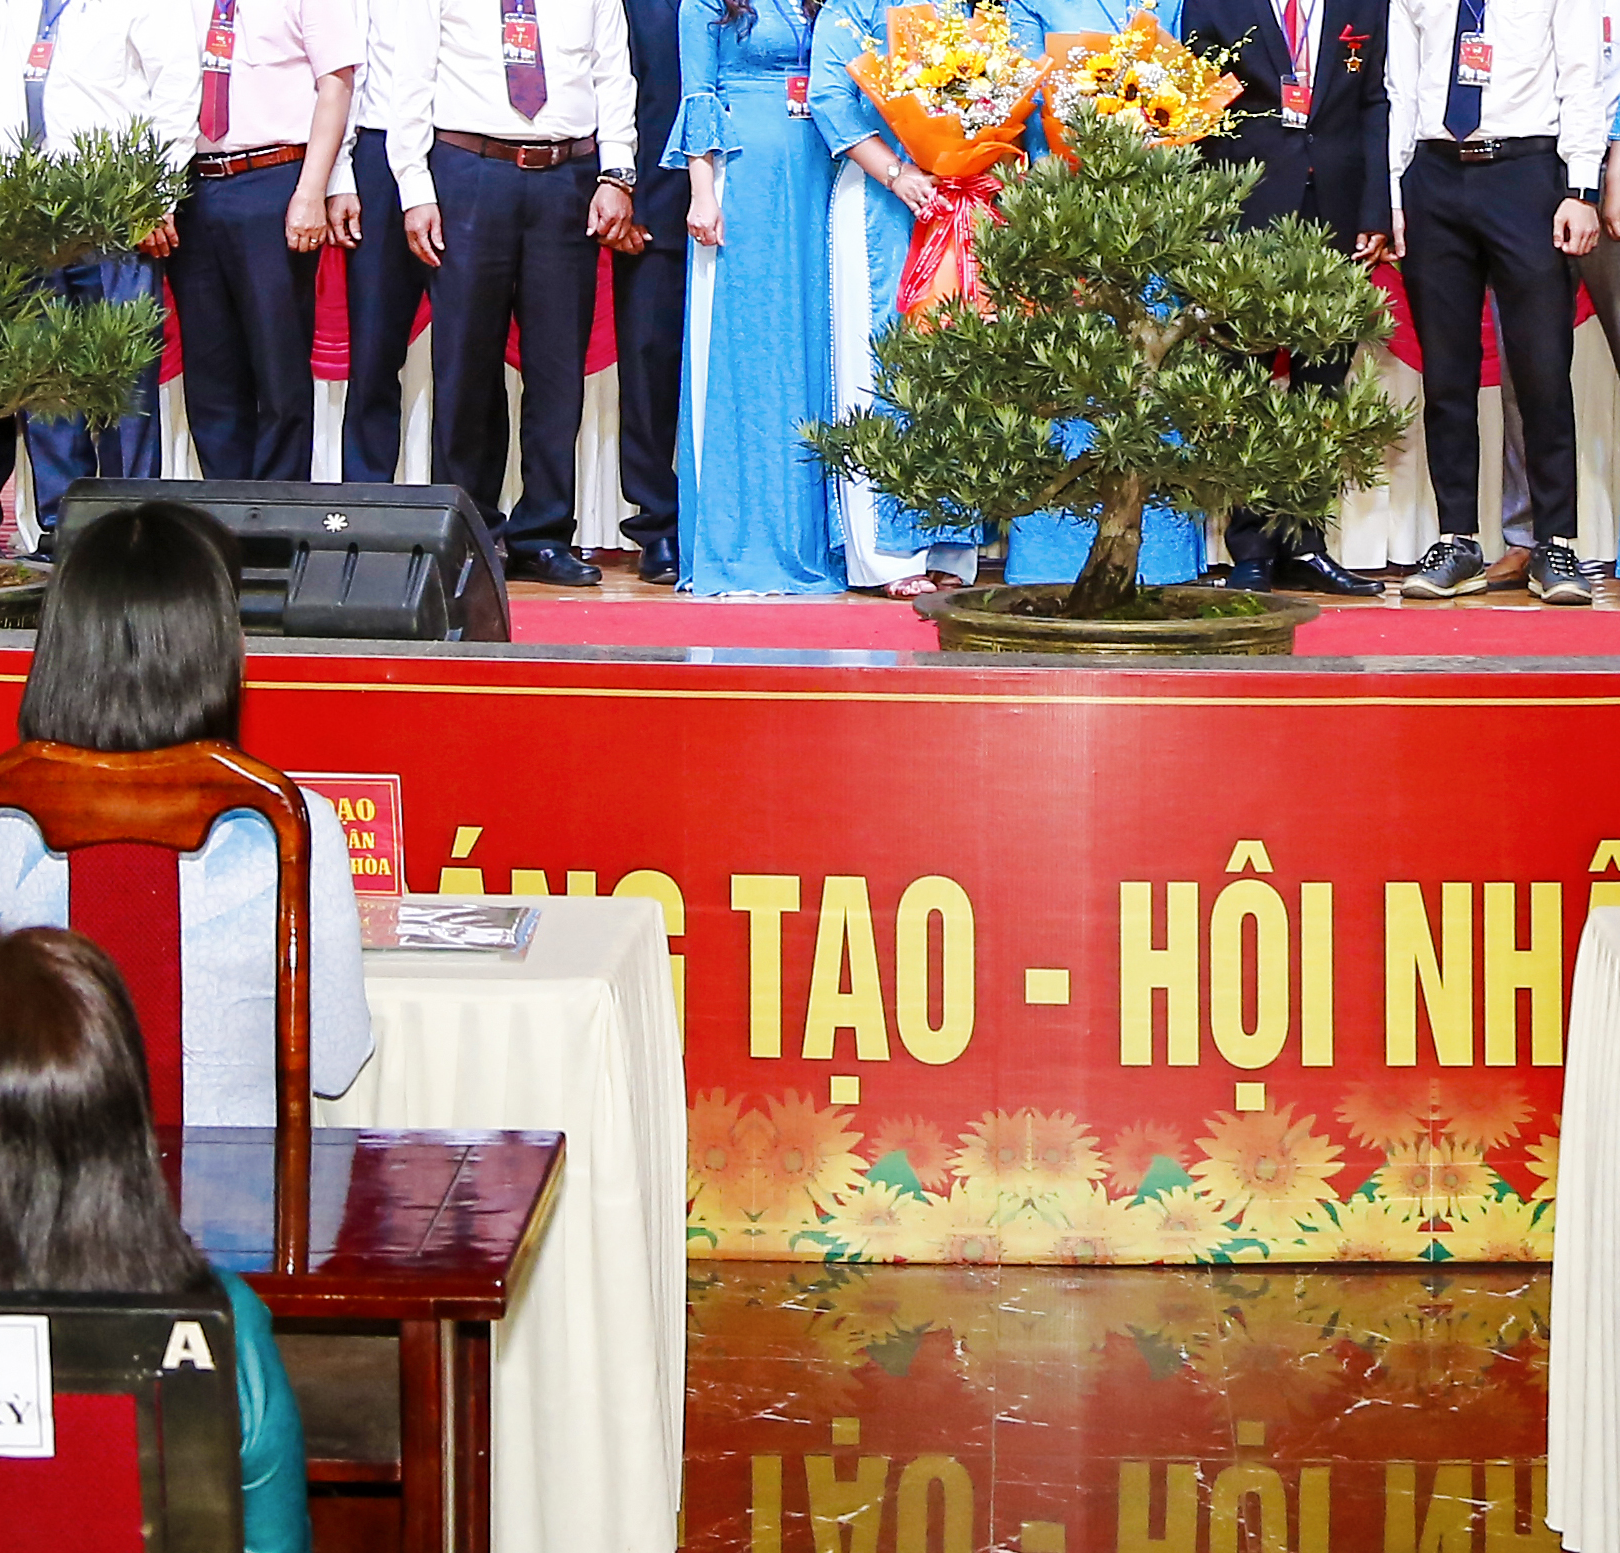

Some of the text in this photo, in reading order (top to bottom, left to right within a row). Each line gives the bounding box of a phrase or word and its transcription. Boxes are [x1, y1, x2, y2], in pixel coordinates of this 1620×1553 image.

[325, 797, 376, 826] ẠO
[344, 828, 375, 850] ÂN
[350, 854, 392, 876] HÒA
[729, 874, 976, 1105] TẠO
[1118, 839, 1334, 1111] HỘI
[162, 1320, 217, 1370] A
